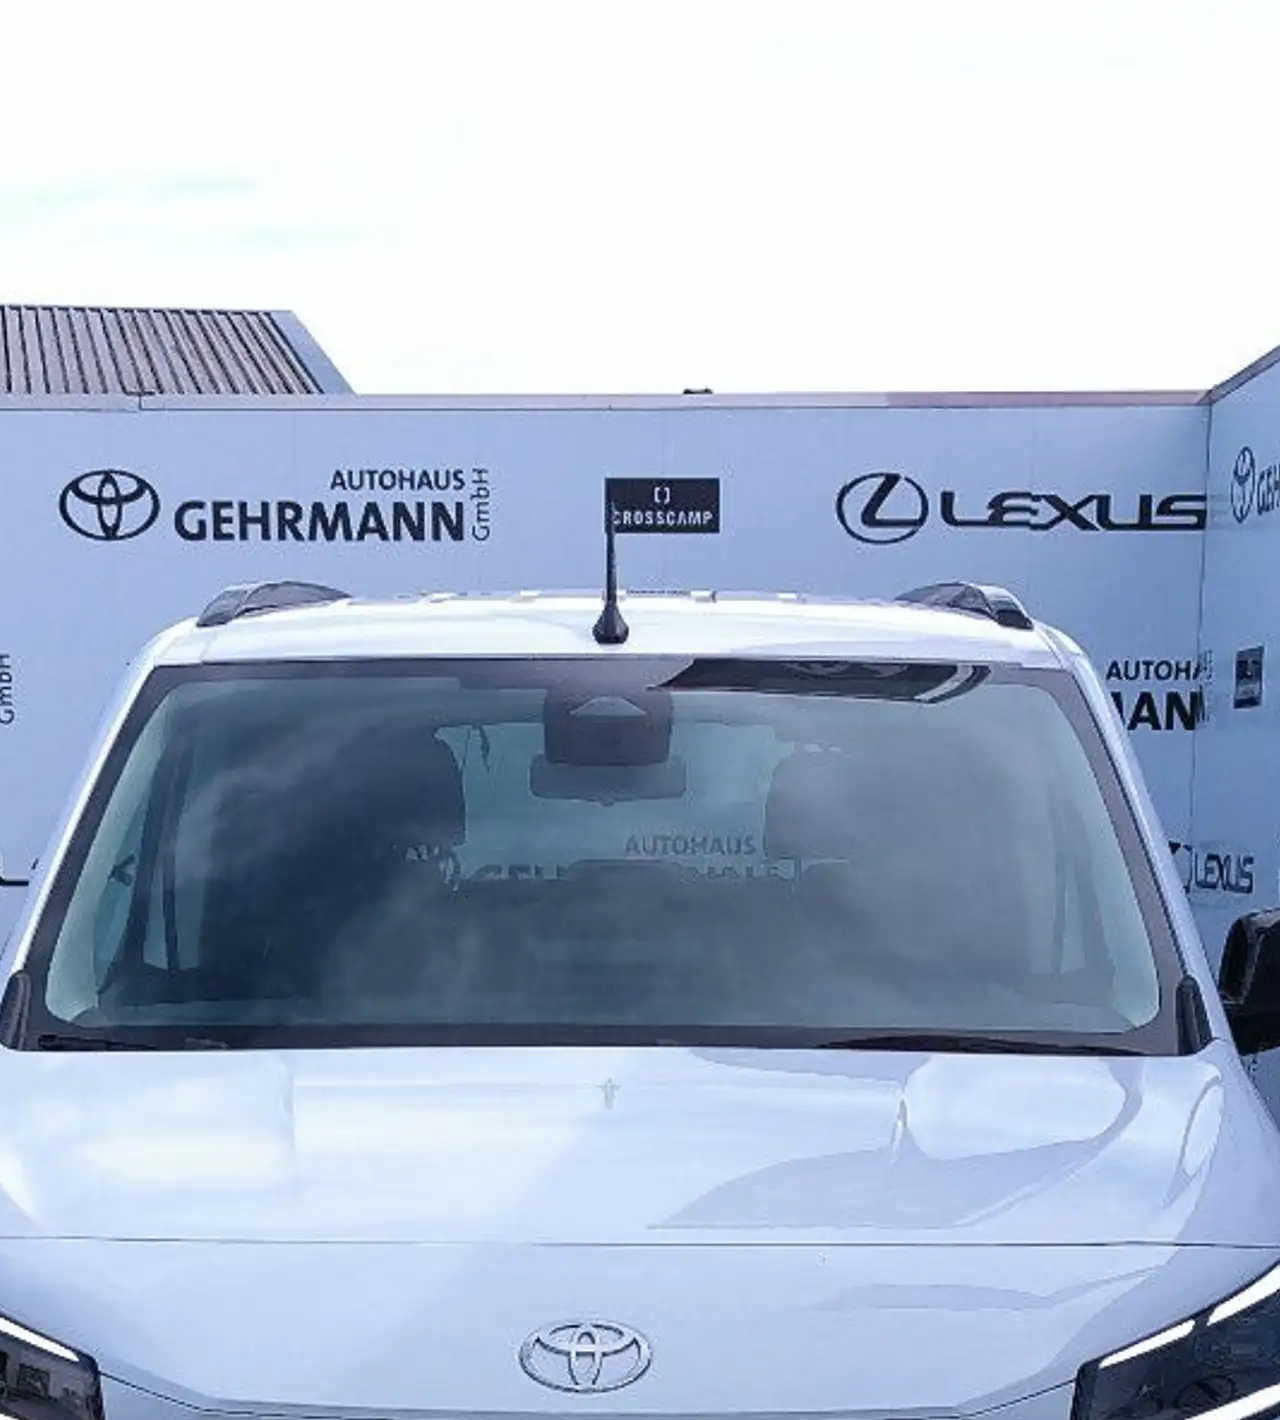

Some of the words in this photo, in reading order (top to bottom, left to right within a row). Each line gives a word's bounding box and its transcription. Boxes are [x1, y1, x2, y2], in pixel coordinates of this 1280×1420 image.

[330, 469, 465, 491] AUTOHAUS
[174, 501, 465, 542] GEHRMANN
[472, 467, 491, 541] GmbH
[941, 491, 1208, 531] LEXUS
[1194, 852, 1255, 894] LEXUS
